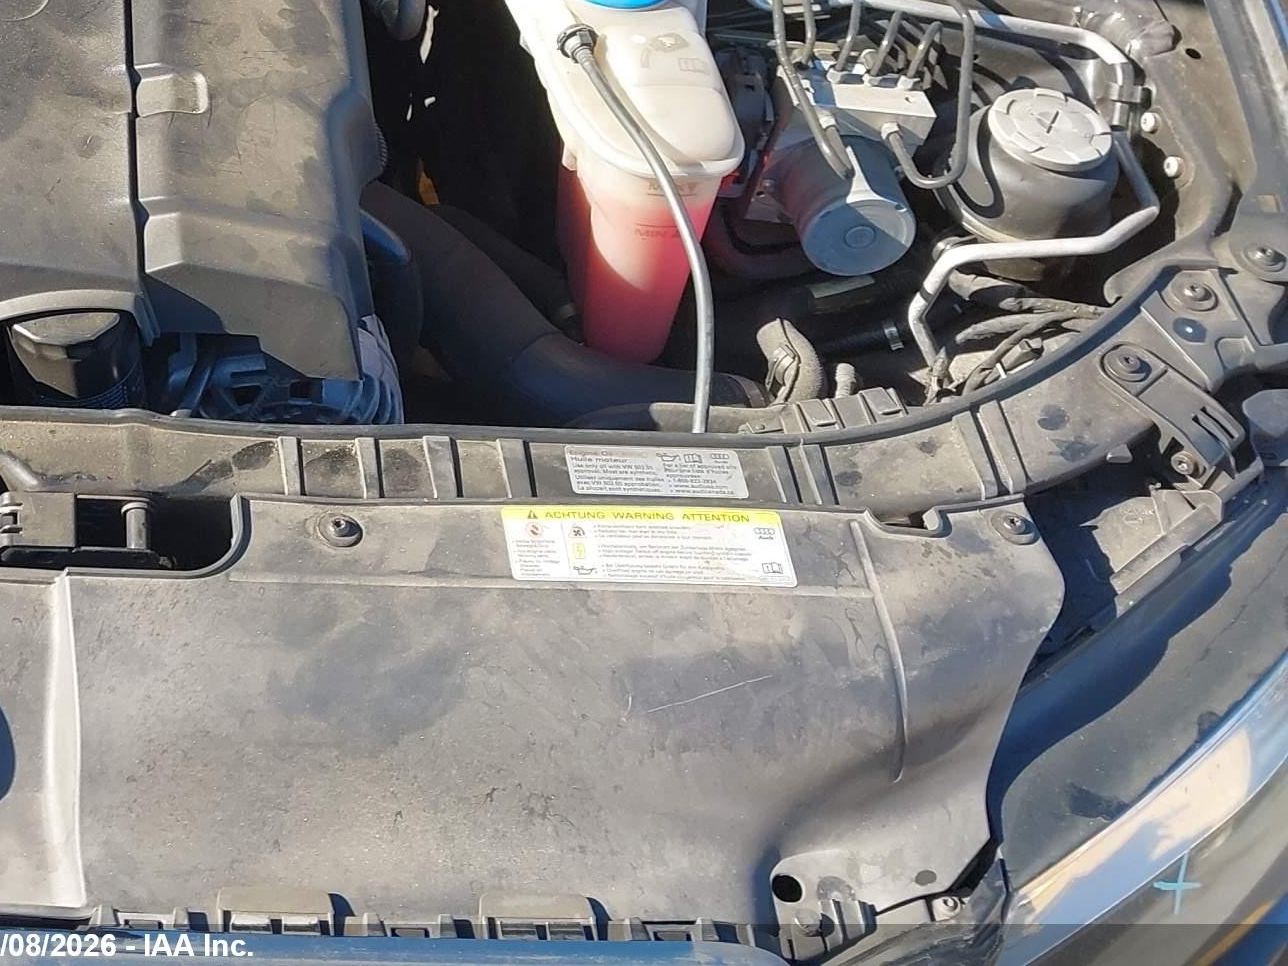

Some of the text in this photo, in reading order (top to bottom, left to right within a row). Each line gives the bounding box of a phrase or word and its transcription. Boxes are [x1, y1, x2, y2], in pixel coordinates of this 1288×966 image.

[545, 511, 750, 523] ACHTUNG WARNING ATTENTION
